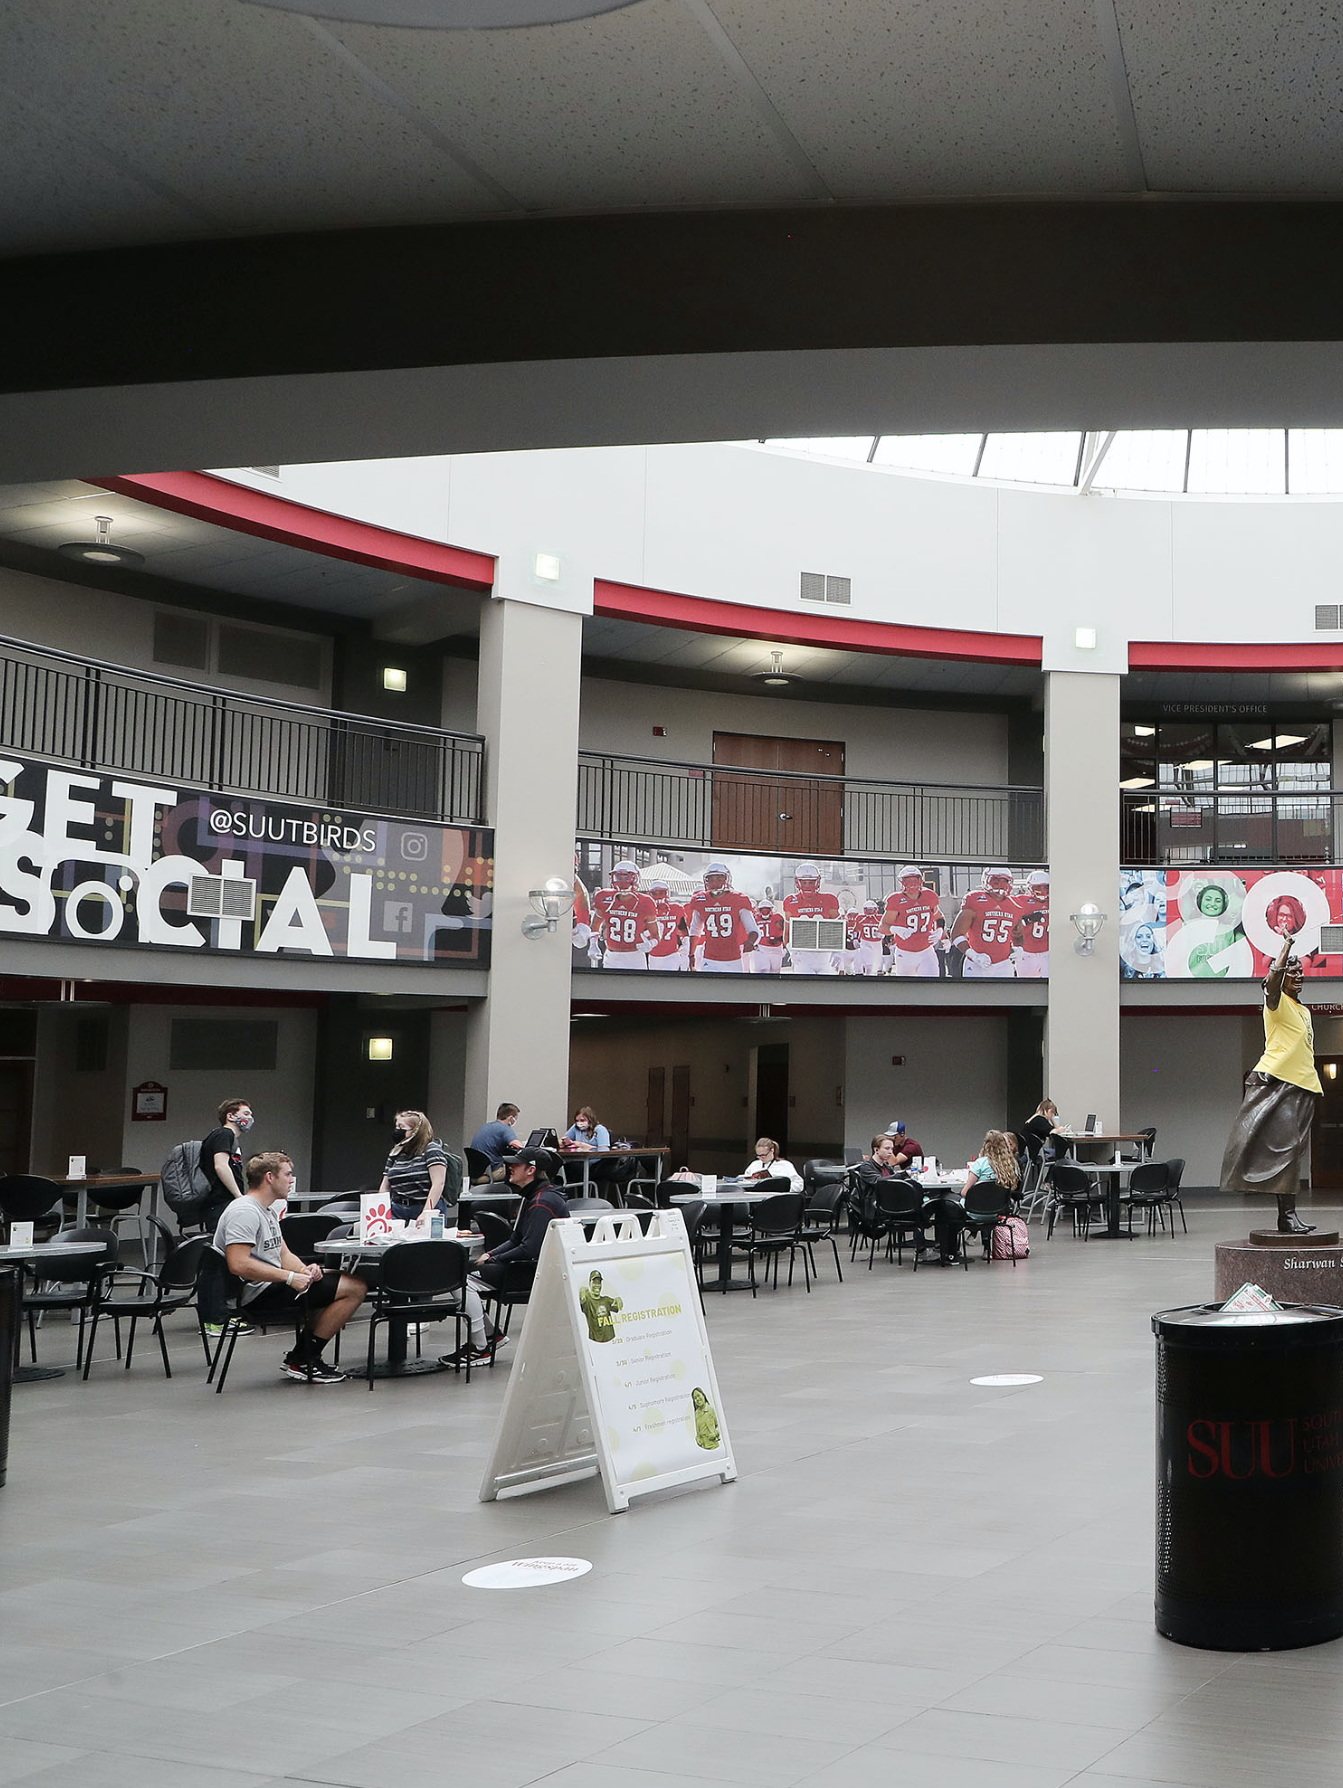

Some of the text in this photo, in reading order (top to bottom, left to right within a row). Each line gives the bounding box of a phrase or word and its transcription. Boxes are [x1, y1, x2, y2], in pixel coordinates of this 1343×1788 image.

[1162, 704, 1268, 713] VICE PRESIDENT'S OFFICE
[209, 808, 377, 854] @SUUTBIRDS
[609, 917, 637, 943] 28
[705, 913, 733, 938] 49
[906, 912, 931, 933] 97
[982, 919, 1013, 943] 55
[1283, 1256, 1336, 1270] Sharwan
[597, 1304, 683, 1327] FALL REGISTRATION
[645, 1329, 672, 1339] Registration
[645, 1352, 672, 1361] Registration
[649, 1373, 676, 1383] Registration
[664, 1392, 691, 1402] Registration
[1187, 1418, 1297, 1480] SUU
